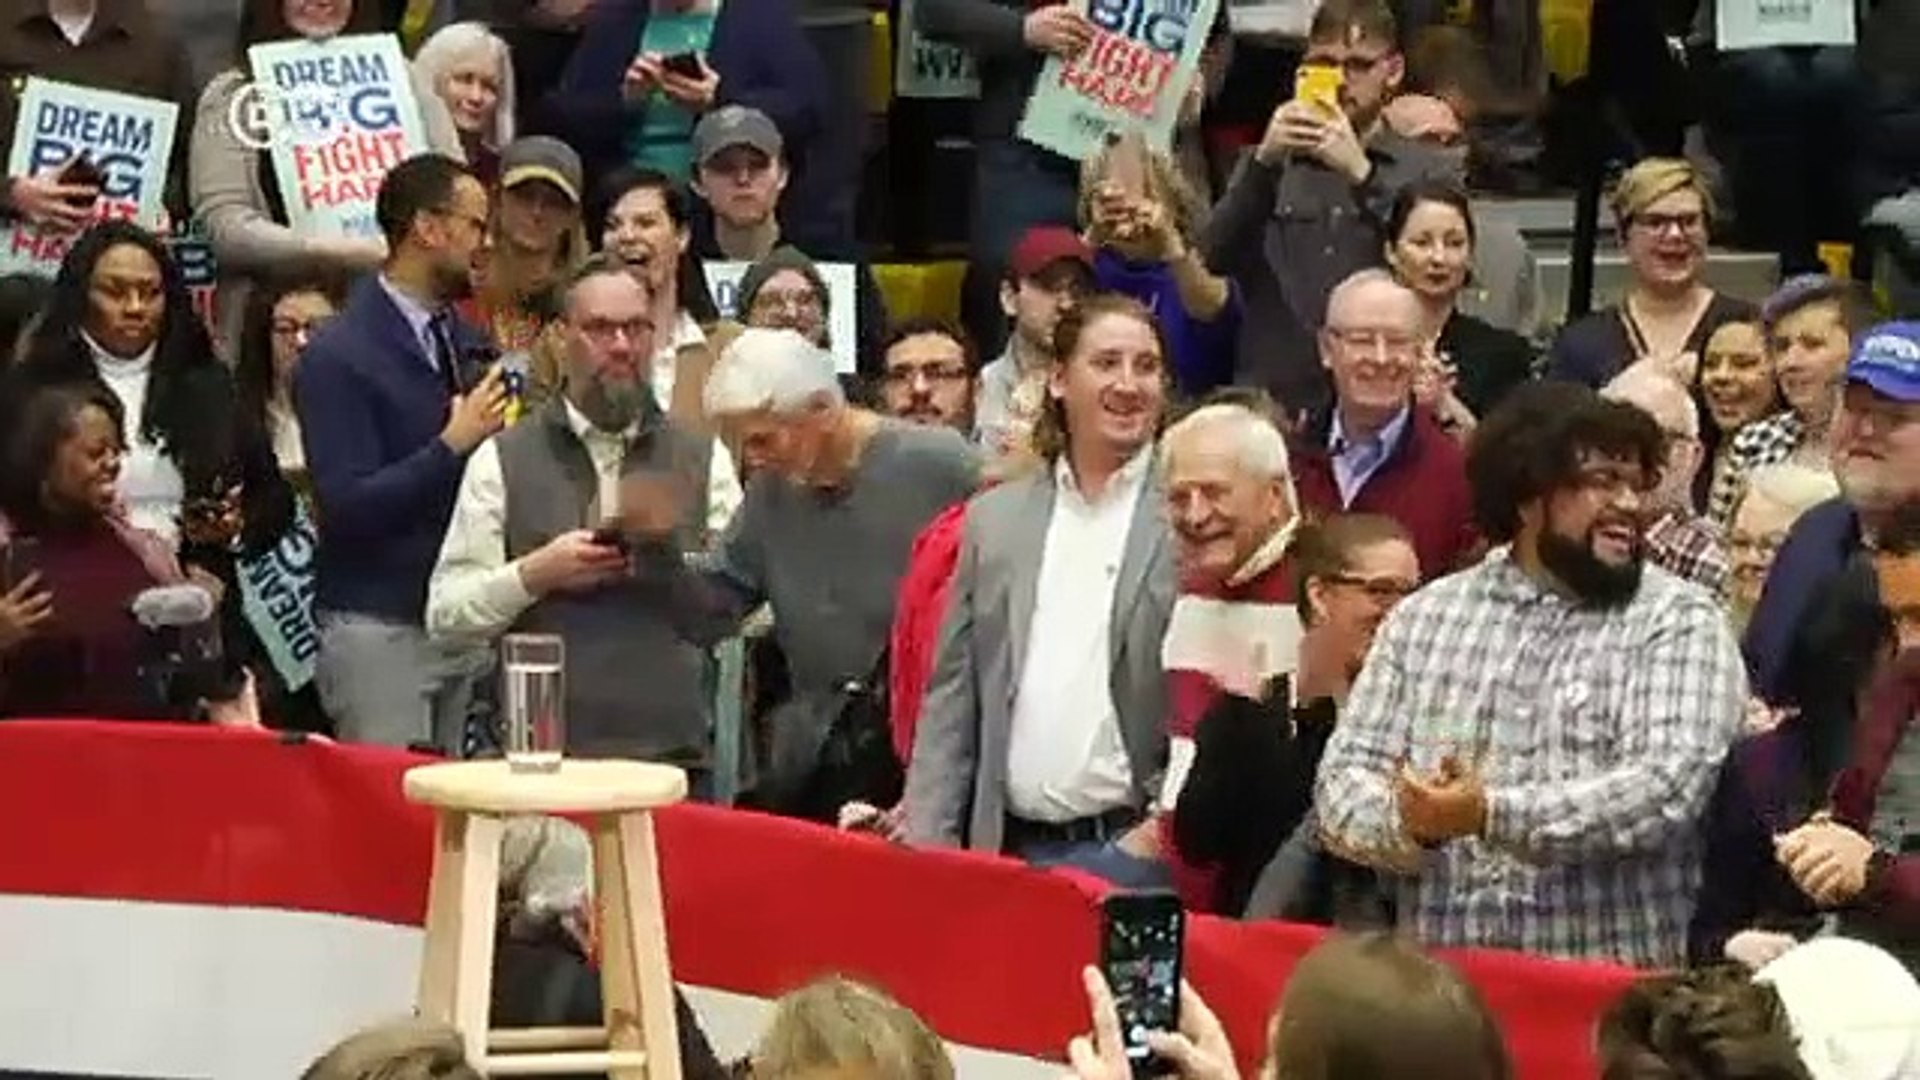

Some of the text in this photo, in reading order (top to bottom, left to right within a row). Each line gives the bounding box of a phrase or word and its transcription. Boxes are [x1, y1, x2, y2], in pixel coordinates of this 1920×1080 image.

[273, 53, 389, 89] DREAM
[37, 101, 153, 152] DREAM
[30, 139, 143, 202] BG
[293, 131, 403, 181] FIGHT
[301, 176, 380, 211] HAR
